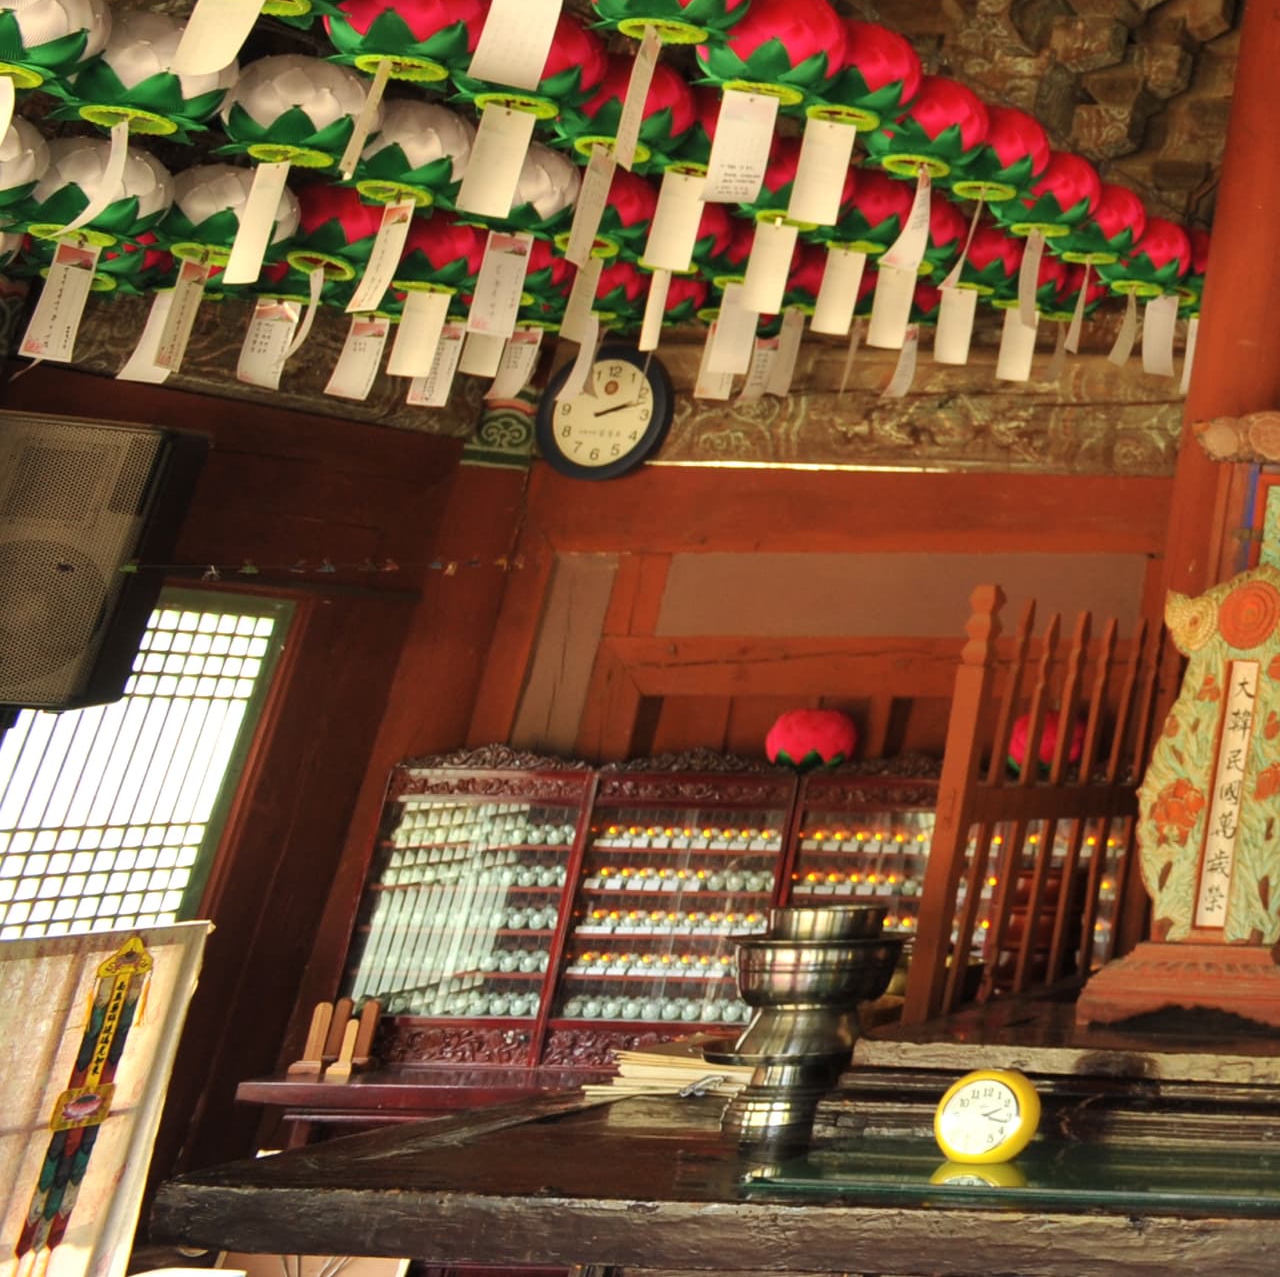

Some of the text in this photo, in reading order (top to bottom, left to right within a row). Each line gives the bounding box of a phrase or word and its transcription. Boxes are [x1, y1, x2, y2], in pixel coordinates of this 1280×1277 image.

[609, 365, 623, 378] 12
[631, 372, 637, 383] 1
[562, 404, 571, 416] 9
[640, 409, 650, 421] 3
[562, 426, 571, 438] 8
[628, 430, 638, 441] 4
[573, 441, 583, 453] 7
[610, 444, 621, 456] 5
[589, 448, 599, 460] 6
[971, 1089, 980, 1099] 11
[983, 1088, 994, 1098] 12
